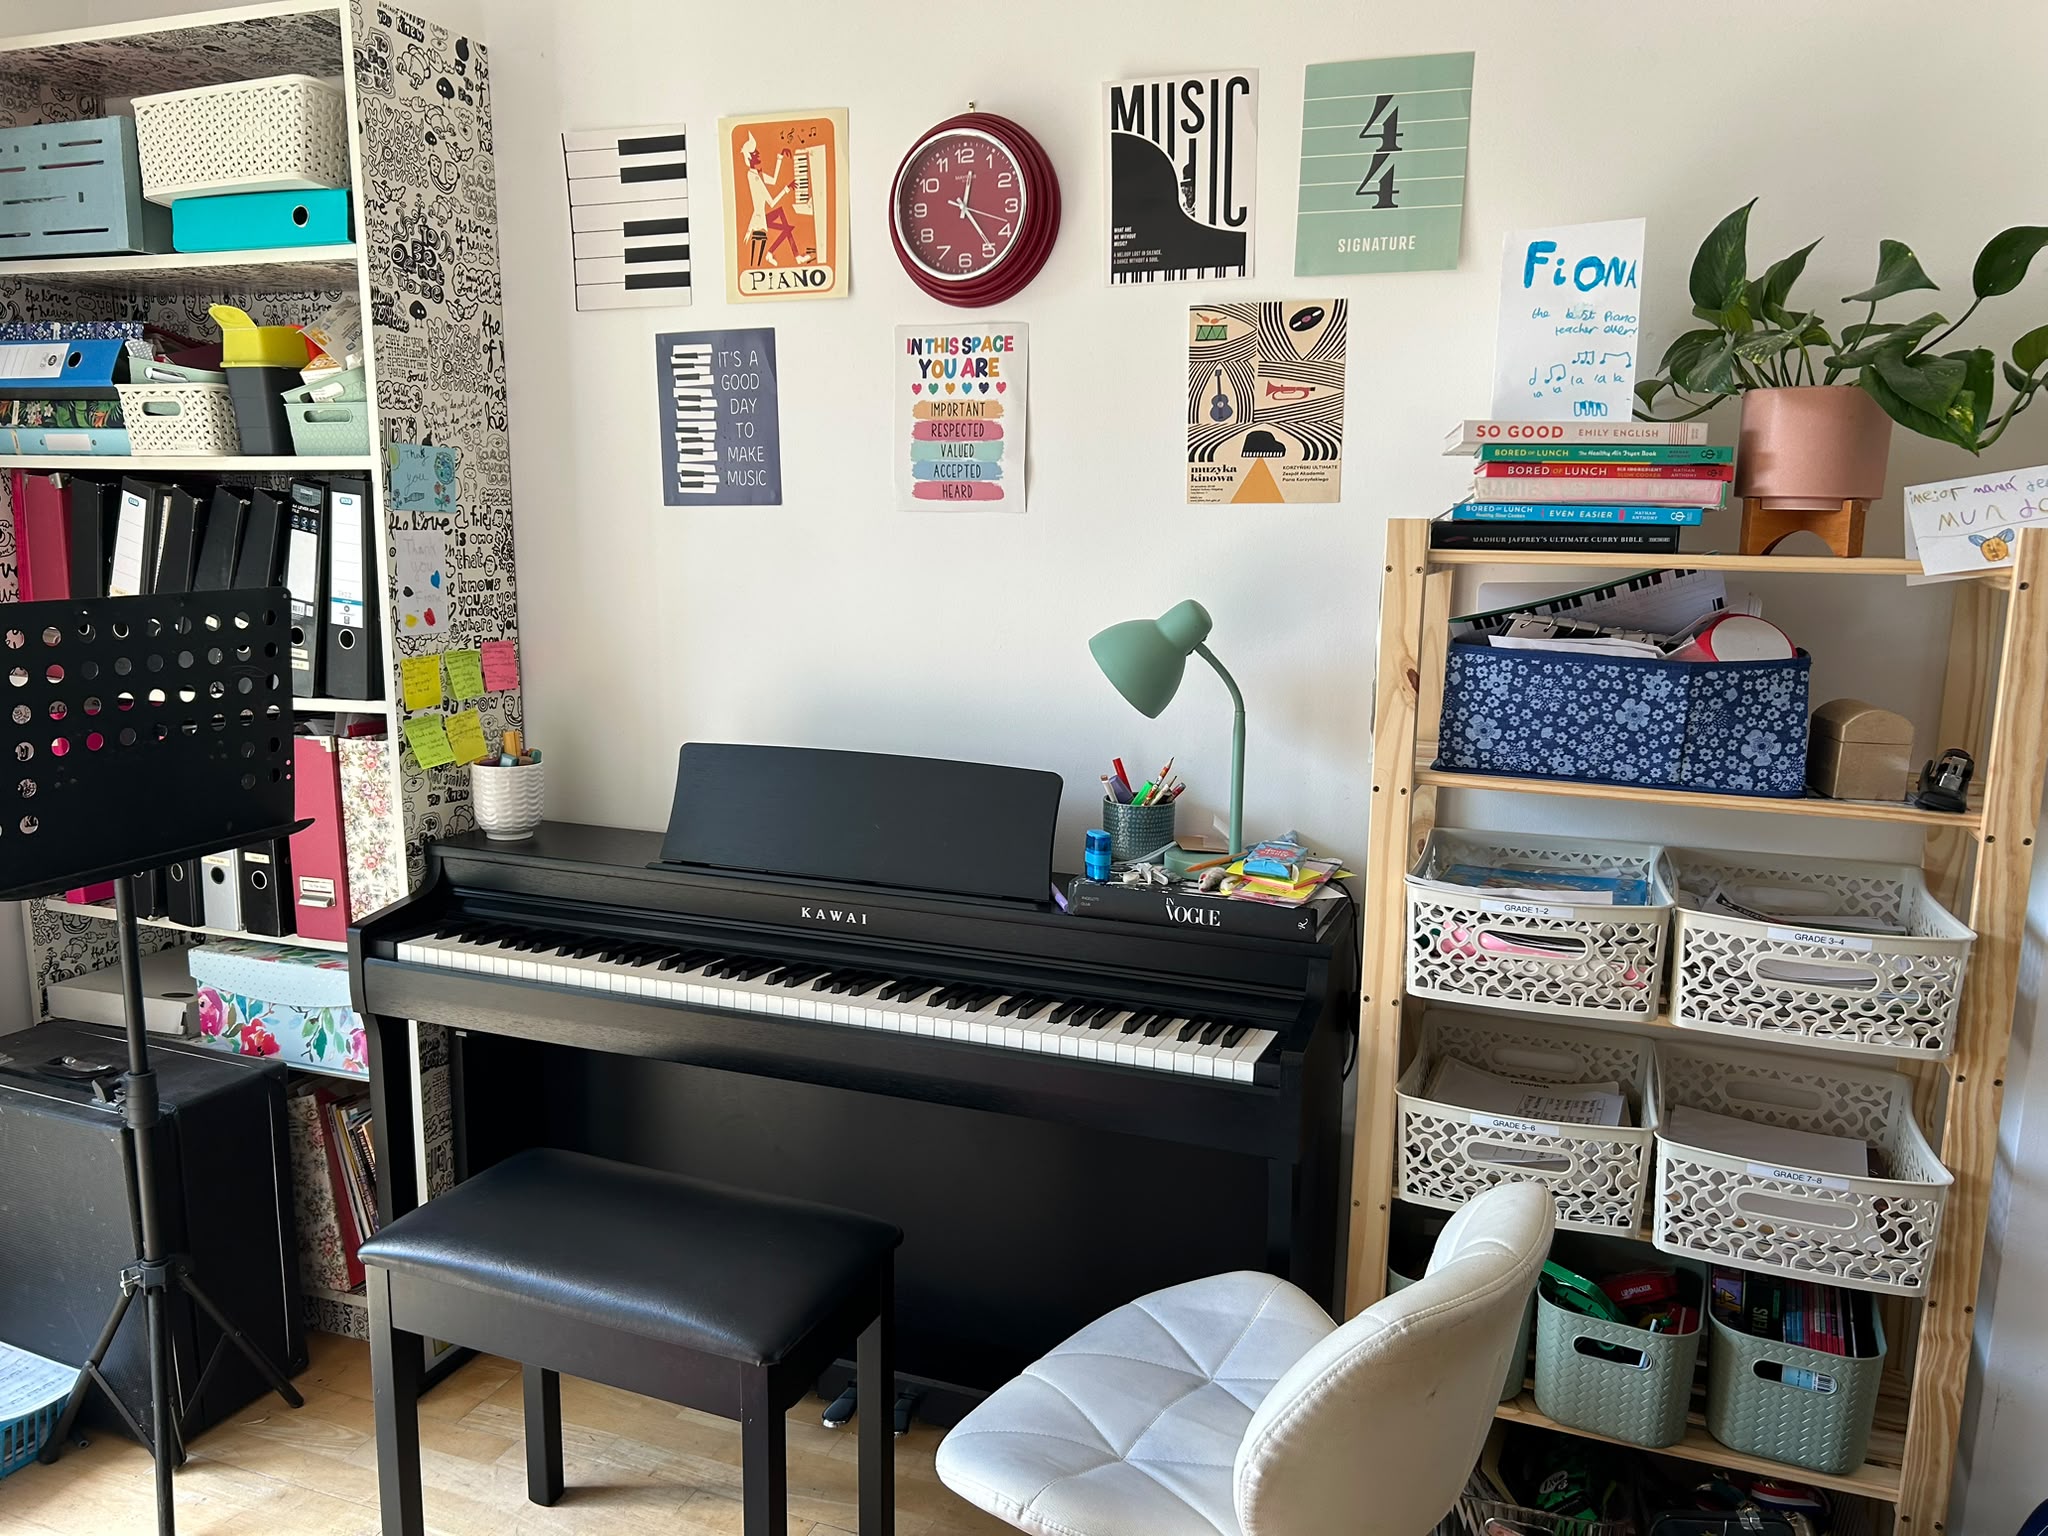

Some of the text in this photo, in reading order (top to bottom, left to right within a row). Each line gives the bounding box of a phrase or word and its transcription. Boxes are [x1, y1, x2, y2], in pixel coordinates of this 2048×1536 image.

[1359, 94, 1403, 152] 4
[955, 148, 975, 164] 12
[1111, 76, 1250, 227] MUSIC
[936, 158, 948, 173] 11
[986, 154, 993, 169] 1
[920, 178, 940, 193] 10
[997, 172, 1012, 188] 2
[1356, 153, 1400, 208] 4
[914, 203, 927, 218] 9
[1005, 198, 1019, 213] 3
[921, 228, 934, 243] 8
[998, 223, 1011, 238] 4
[982, 243, 996, 258] 5
[1338, 235, 1416, 253] SIGNATURE
[936, 245, 951, 260] 7
[958, 253, 972, 268] 6
[1531, 307, 1550, 319] the
[1555, 324, 1598, 336] teacher
[907, 335, 1014, 355] IN THIS SPACE
[718, 350, 758, 368] IT'S A
[918, 357, 1000, 379] YOU ARE
[721, 373, 759, 391] GOOD
[730, 398, 757, 414] DAY
[931, 402, 985, 417] IMPORTANT
[736, 421, 754, 438] TO
[931, 423, 985, 437] RESPECTED
[1477, 425, 1659, 438] SO GOOD EMILY ENGLISH
[727, 446, 765, 462] MAKE
[941, 443, 975, 458] VALUED
[1537, 449, 1569, 457] LUNCH
[933, 463, 981, 478] ACCEPTED
[1191, 464, 1237, 475] muzyka
[1508, 466, 1550, 475] BORED
[1565, 467, 1607, 475] LUNCH
[727, 469, 766, 486] MUSIC
[1191, 474, 1233, 482] kinowa
[943, 484, 973, 498] HEARD
[458, 573, 500, 593] knows
[1166, 897, 1174, 905] IN
[801, 907, 867, 925] KAWAI
[1166, 905, 1221, 927] VOGUE
[1504, 905, 1533, 913] GRADE
[1794, 934, 1827, 944] GRADE
[1493, 1120, 1520, 1129] GRADE
[1774, 1170, 1805, 1181] GRADE
